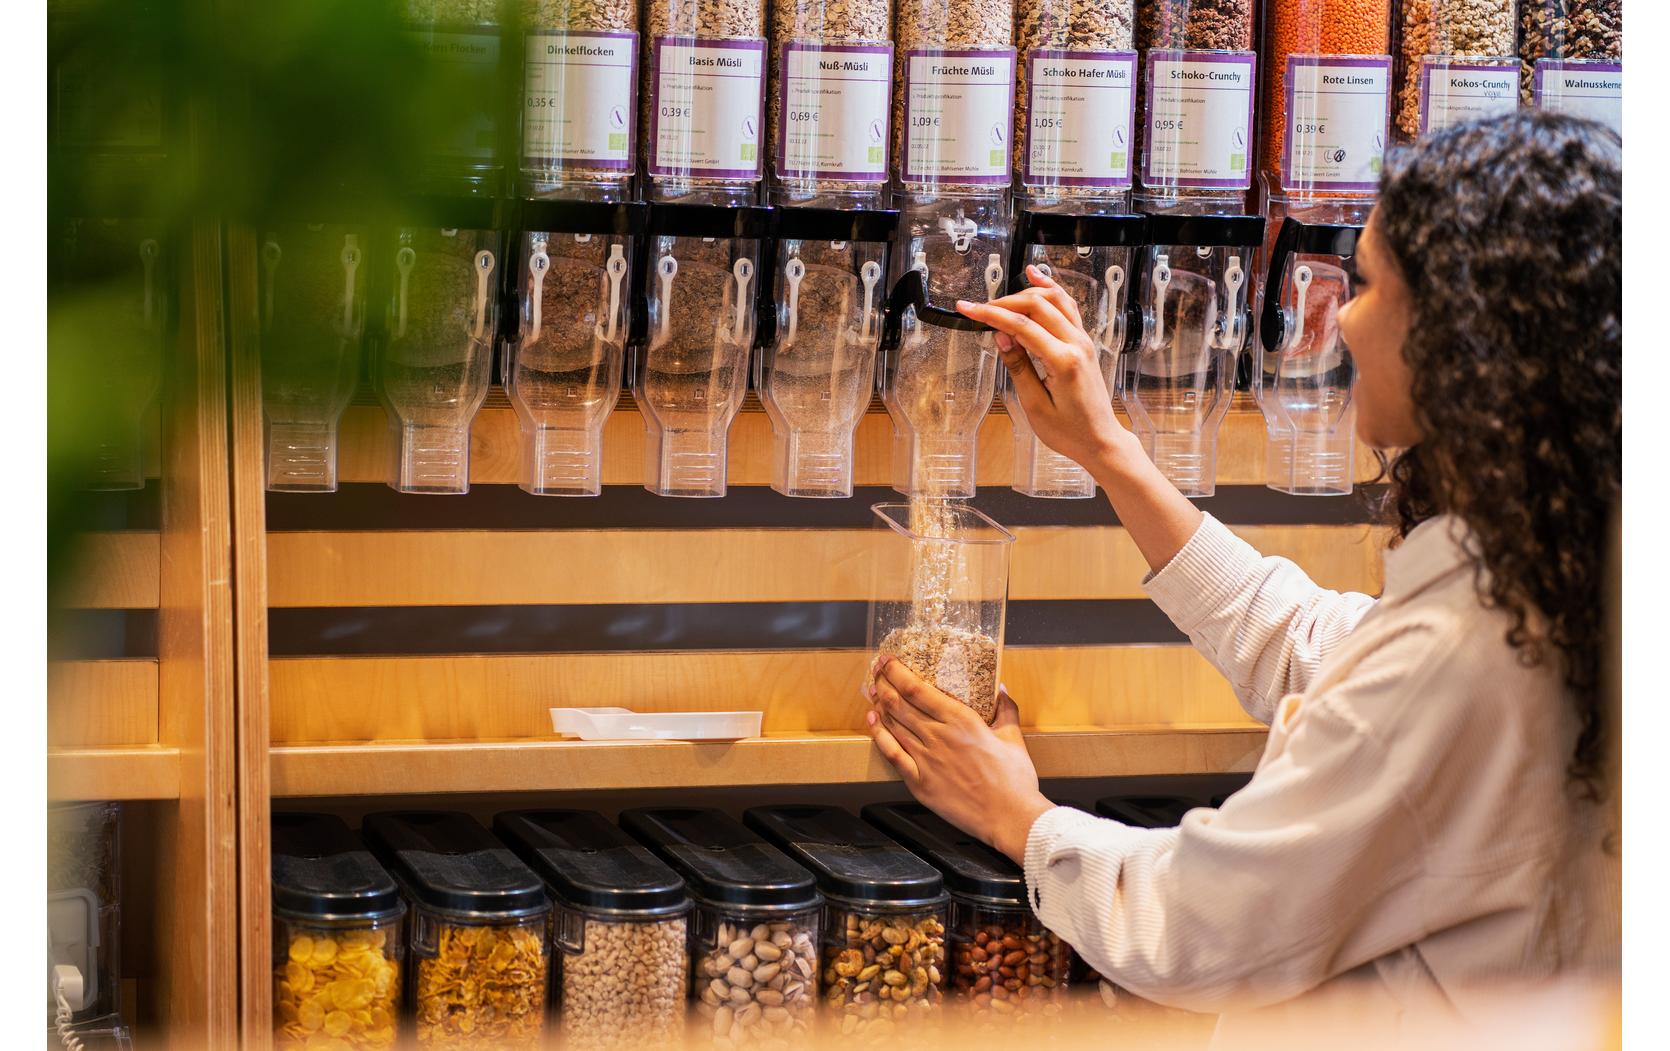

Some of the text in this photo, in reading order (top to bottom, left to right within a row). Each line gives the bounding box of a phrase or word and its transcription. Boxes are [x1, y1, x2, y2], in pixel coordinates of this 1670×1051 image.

[547, 45, 614, 56] Dinkelflocken
[689, 57, 742, 67] Basis Müsli
[819, 61, 868, 71] Nuß-Müsli
[932, 66, 995, 76] Früchte Müsli
[1043, 67, 1126, 79] Schoko Hafer Müsli
[1171, 70, 1241, 83] Schoko-Crunchy
[1323, 75, 1374, 85] Rote Linsen
[1450, 79, 1510, 90] Kokos-Crunchy
[1564, 79, 1622, 89] Walnusskerne
[527, 98, 556, 108] 0,35 €
[661, 107, 691, 118] 0,39 €
[790, 111, 819, 122] 0,69 €
[912, 117, 940, 127] 1,09 €
[1034, 118, 1063, 129] 1,05 €
[1155, 120, 1184, 131] 0,95 €
[1296, 124, 1325, 134] 039 €
